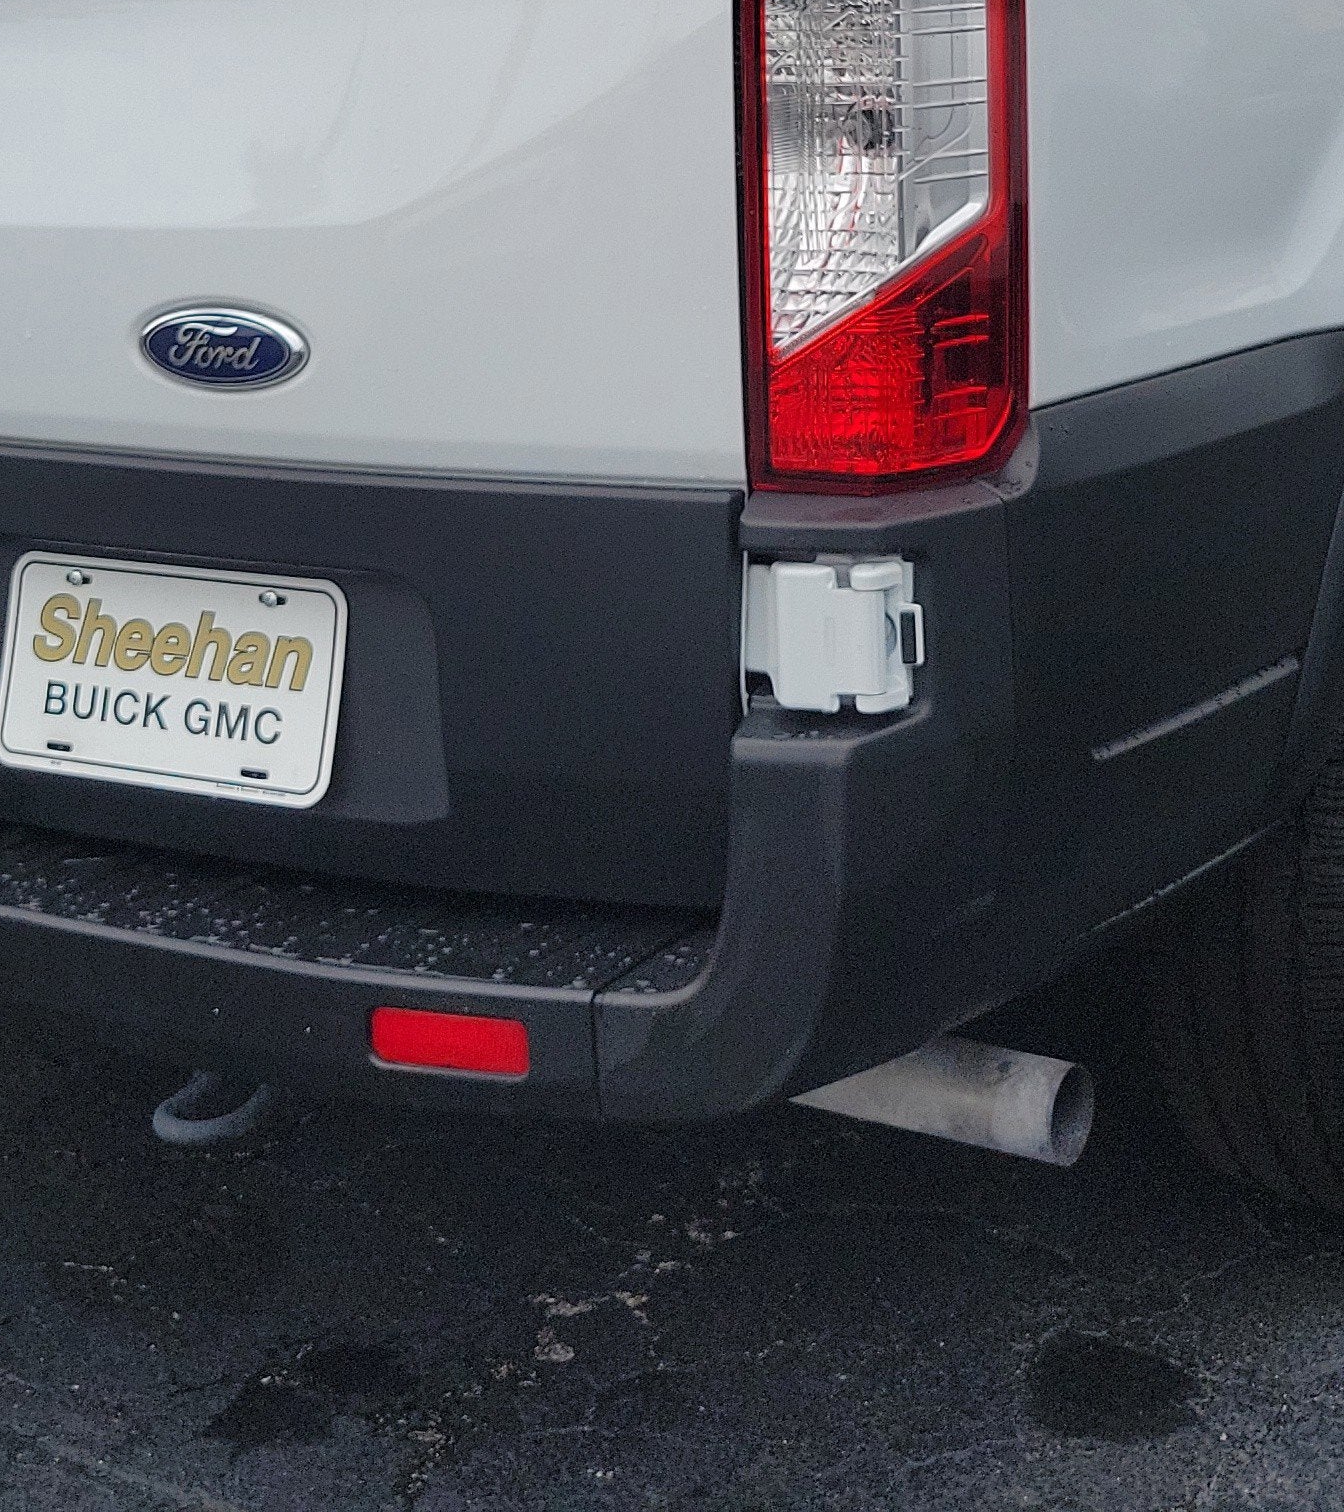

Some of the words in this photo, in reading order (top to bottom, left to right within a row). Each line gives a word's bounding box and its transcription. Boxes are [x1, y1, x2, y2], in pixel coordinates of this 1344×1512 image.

[169, 323, 262, 371] Ford
[32, 593, 314, 692] Sheehan
[44, 679, 171, 731] BUICK
[184, 698, 283, 746] GMC
